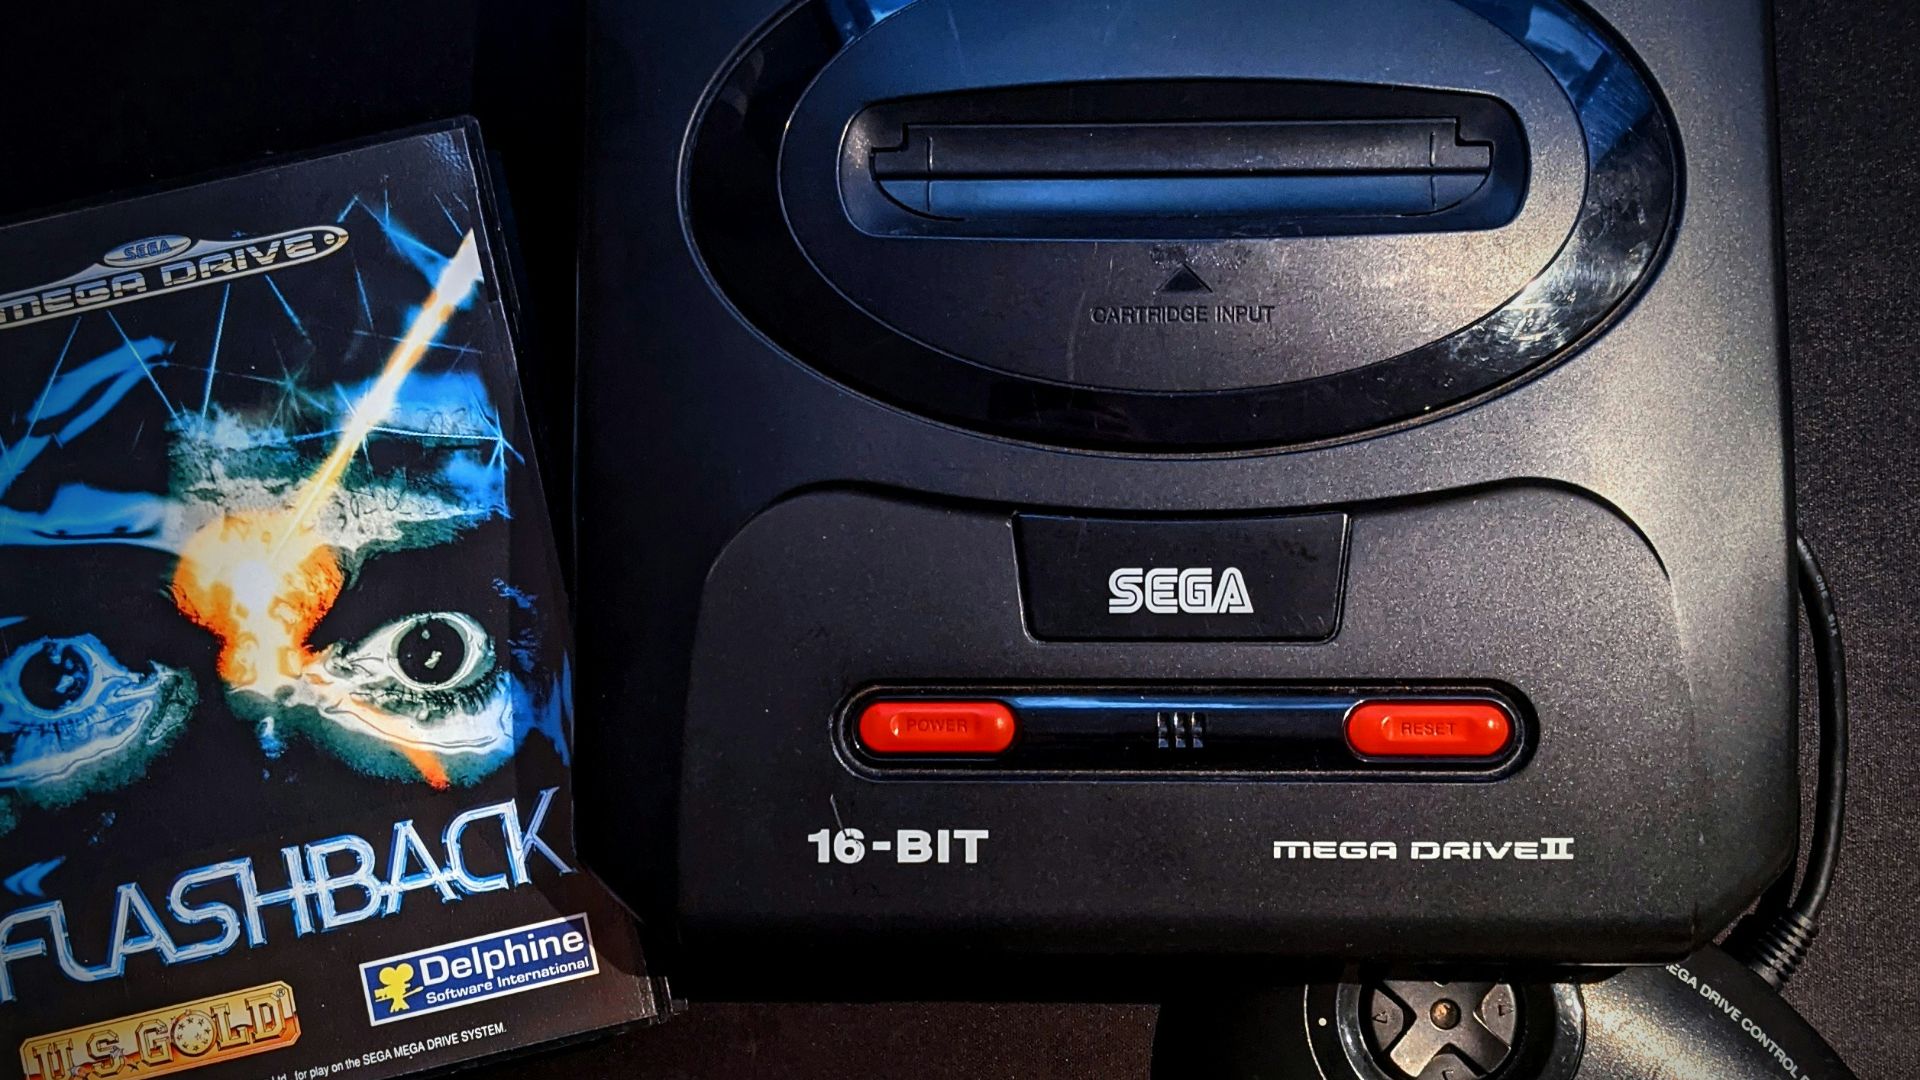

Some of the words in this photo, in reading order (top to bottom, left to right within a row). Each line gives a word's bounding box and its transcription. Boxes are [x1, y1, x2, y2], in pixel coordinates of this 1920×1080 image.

[123, 239, 173, 260] SEGA
[0, 272, 147, 323] MEGA
[160, 234, 317, 287] DRIVE
[1090, 305, 1208, 324] CARTRIDGE
[1214, 305, 1275, 324] INPUT
[1108, 567, 1254, 613] SEGA
[906, 718, 968, 733] POWER
[1400, 722, 1457, 735] RESET
[808, 828, 989, 864] 16-BIT
[1273, 841, 1397, 859] MEGA
[0, 786, 576, 1002] FLASHBACK
[419, 930, 585, 987] Delphine
[426, 979, 493, 1004] Software
[497, 956, 590, 988] International
[1665, 963, 1697, 989] EGA
[1700, 984, 1741, 1022] DRIVE
[1741, 1017, 1801, 1079] CONTROL
[294, 1069, 307, 1080] for
[309, 1065, 329, 1080] play
[331, 1062, 344, 1072] on
[344, 1057, 361, 1069] the
[362, 1049, 393, 1066] SEGA
[393, 1041, 426, 1058] MEGA
[426, 1033, 460, 1052] DRIVE
[460, 1022, 507, 1043] SYSTEM.
